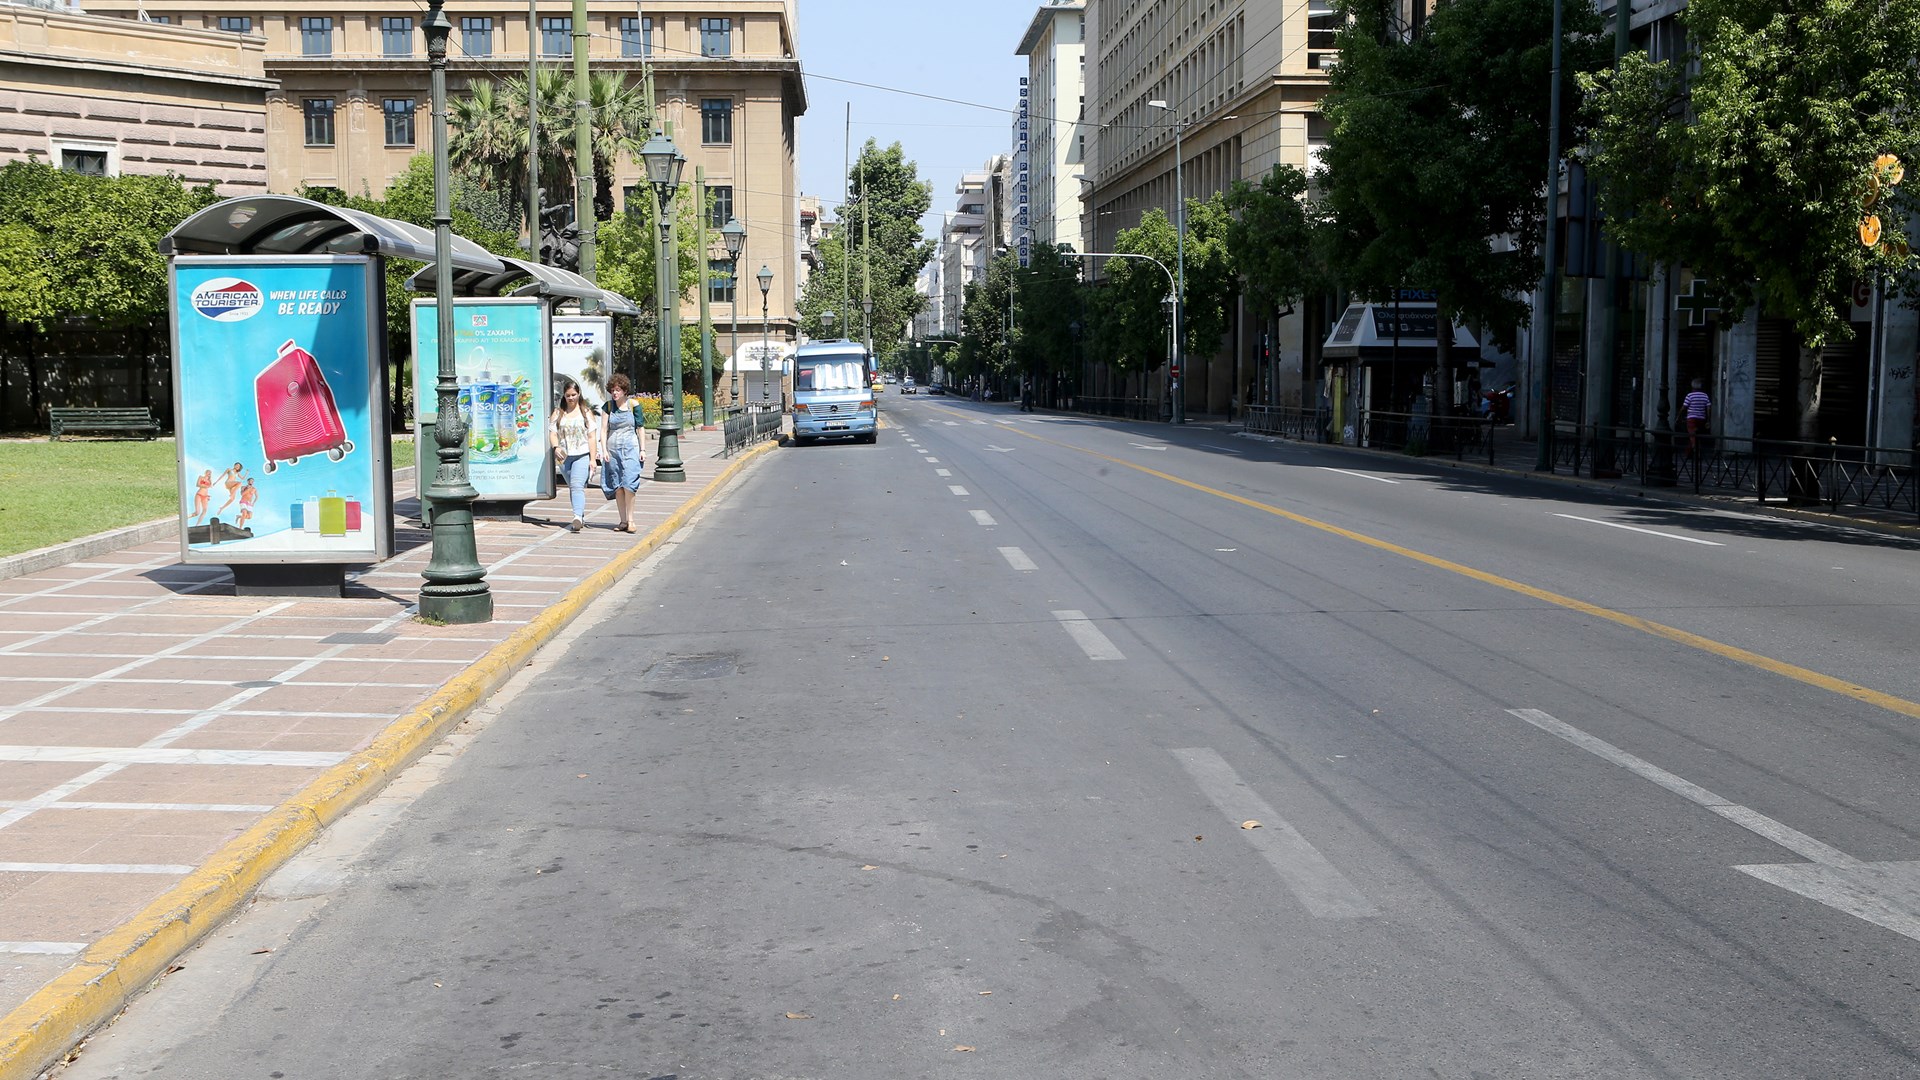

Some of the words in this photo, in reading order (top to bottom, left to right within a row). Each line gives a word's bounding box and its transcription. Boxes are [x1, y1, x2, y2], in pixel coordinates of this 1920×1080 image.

[1020, 77, 1028, 152] ESPERIA
[1020, 162, 1028, 225] PALACE
[1020, 236, 1028, 267] HOT
[270, 290, 296, 300] WHEN
[298, 290, 319, 300] LIFE
[320, 290, 347, 300] CALLS
[278, 302, 295, 315] BE
[298, 302, 340, 315] READY
[552, 333, 594, 345] ΛΙΟΣ
